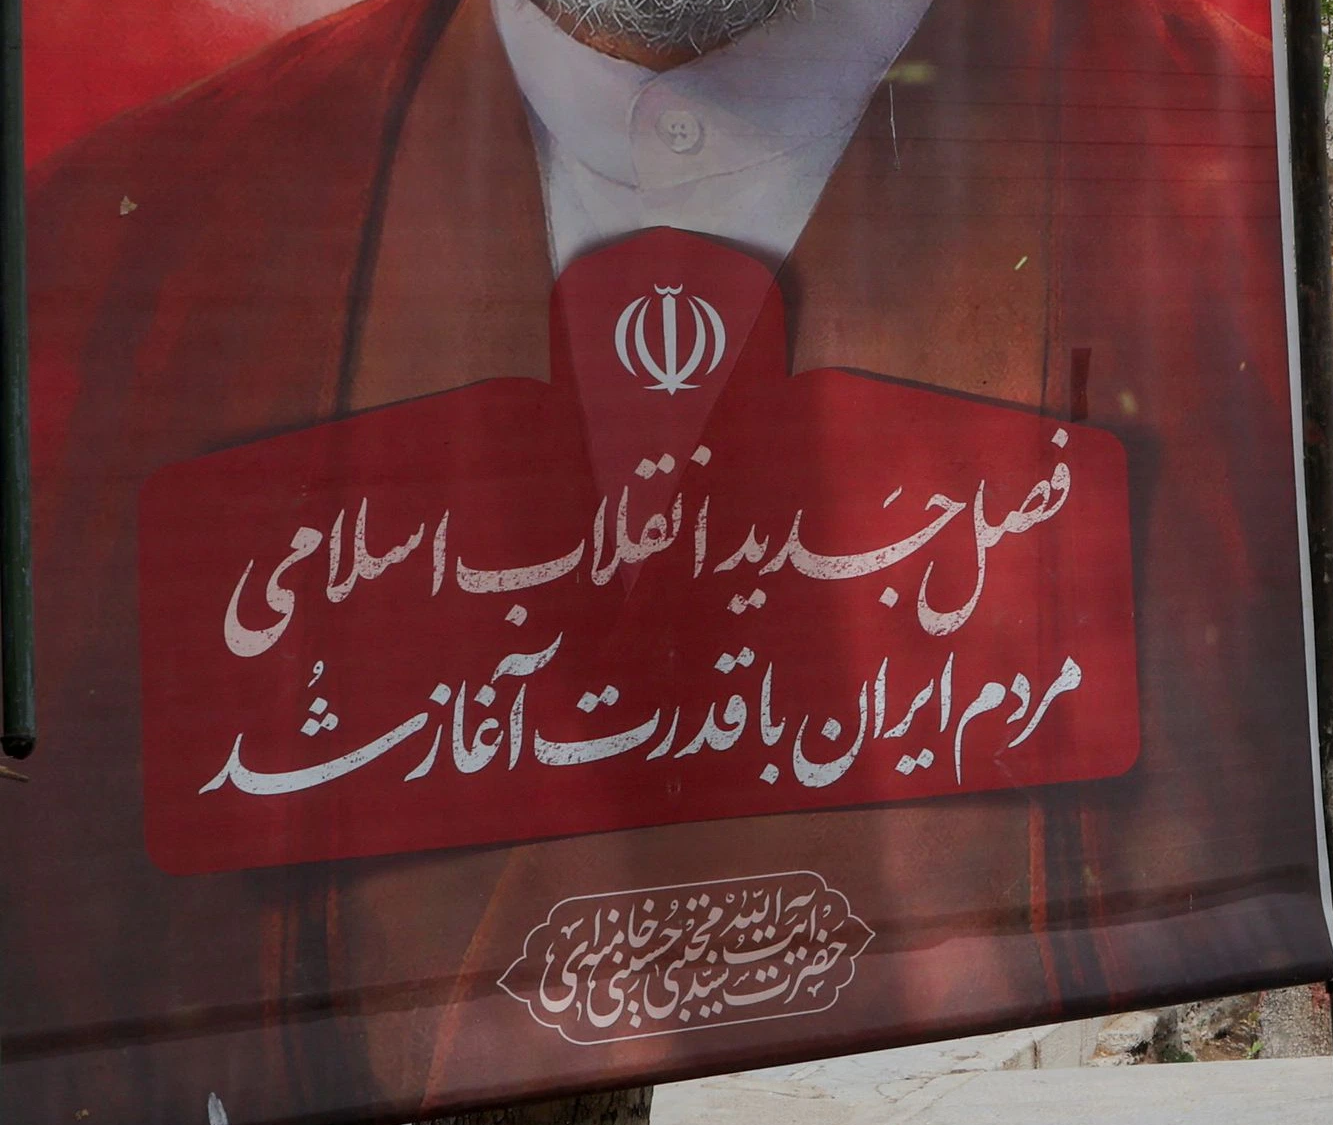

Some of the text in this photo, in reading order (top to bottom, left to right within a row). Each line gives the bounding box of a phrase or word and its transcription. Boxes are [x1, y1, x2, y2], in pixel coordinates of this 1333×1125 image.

[225, 497, 449, 658] اسلامی
[457, 446, 711, 626] انقلاب
[917, 428, 1071, 637] فصل
[404, 632, 563, 783] آغاز
[533, 646, 755, 767] قدرت
[759, 662, 787, 785] با
[792, 651, 955, 789] ایران
[955, 655, 1082, 785] مردم
